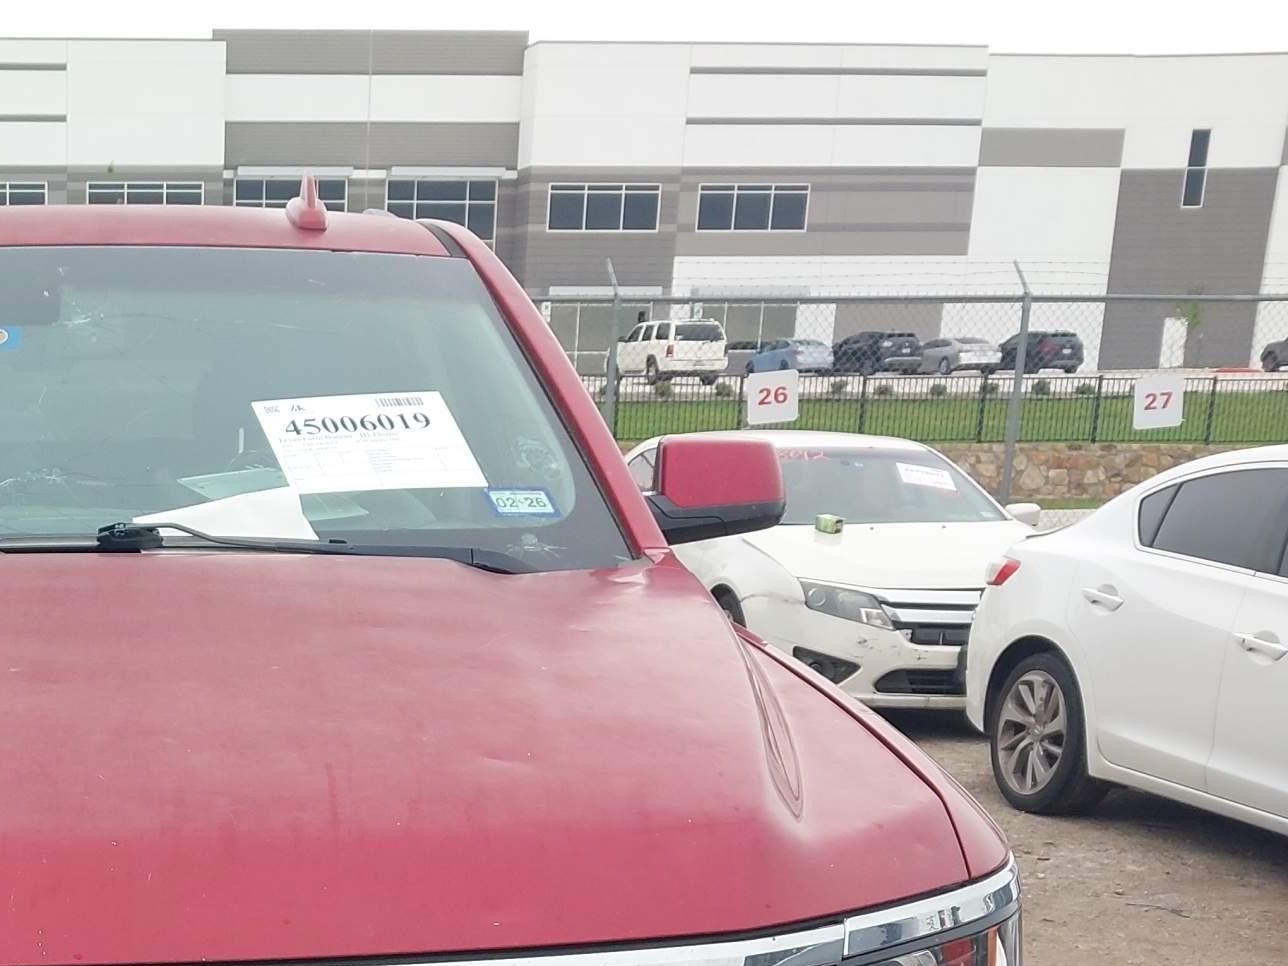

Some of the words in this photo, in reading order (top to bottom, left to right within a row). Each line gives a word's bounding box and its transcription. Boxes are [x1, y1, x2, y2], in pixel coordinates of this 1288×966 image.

[758, 386, 788, 405] 26
[1144, 391, 1173, 411] 27
[285, 412, 431, 435] 45006019
